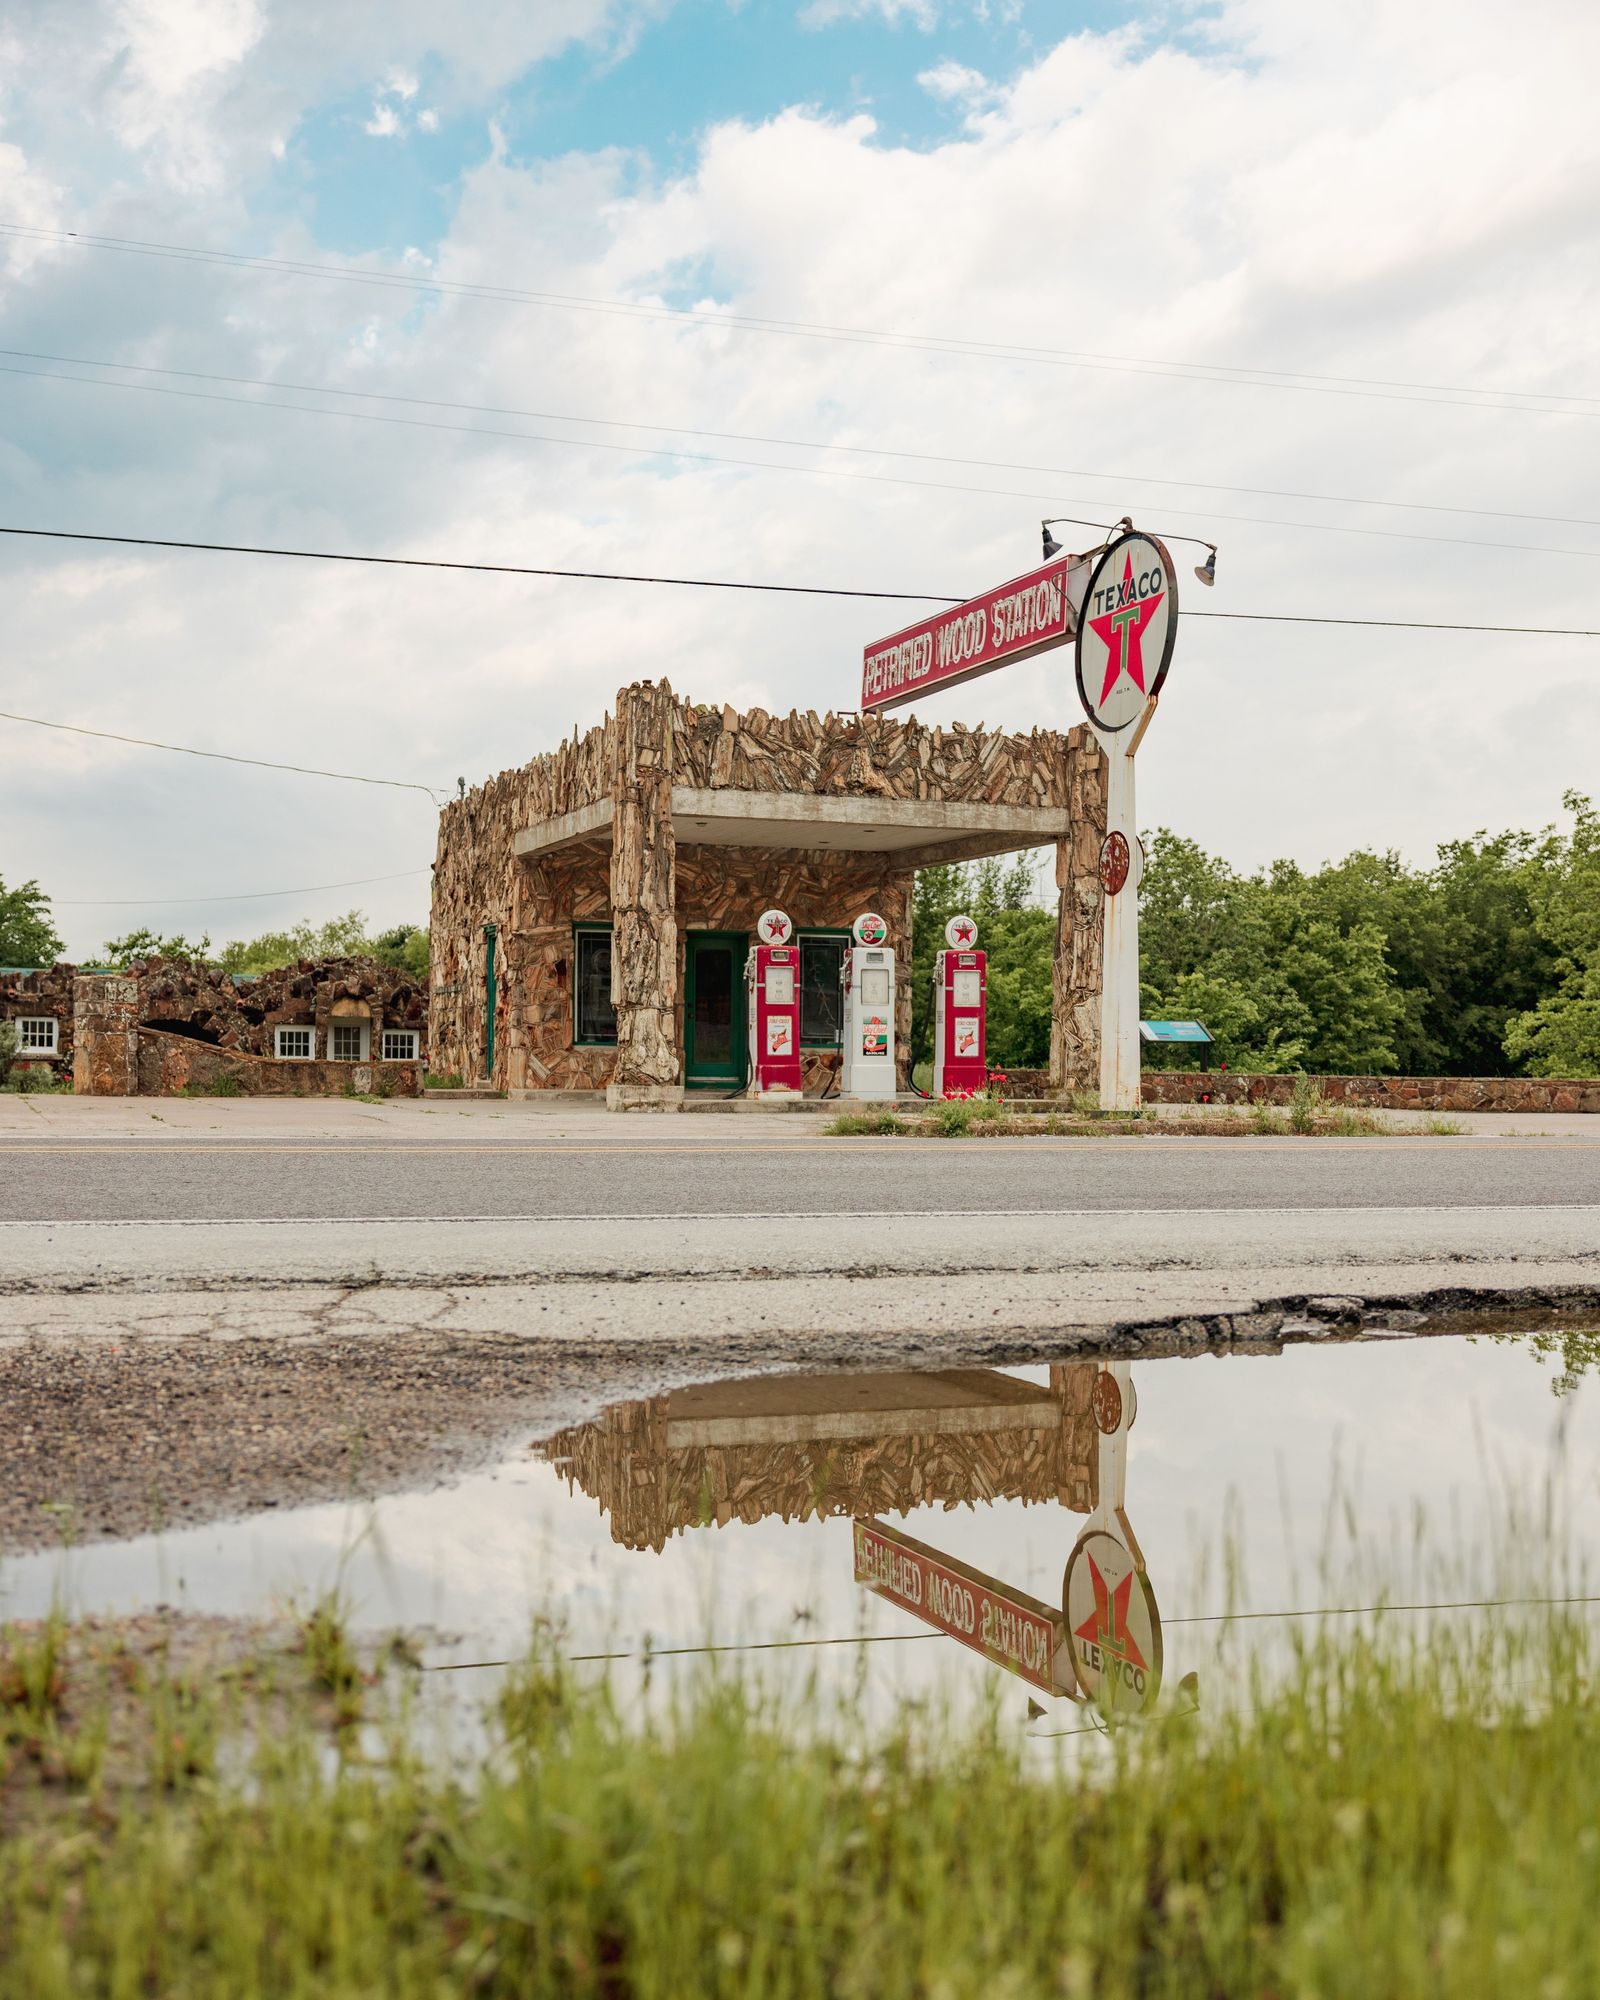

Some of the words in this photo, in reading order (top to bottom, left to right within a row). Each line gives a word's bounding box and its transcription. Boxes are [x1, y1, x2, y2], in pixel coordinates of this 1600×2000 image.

[1094, 567, 1162, 615] TEXACO
[863, 632, 932, 697] PETRIFIED
[936, 609, 987, 668] WOOD
[991, 574, 1062, 647] STATION
[1111, 606, 1140, 671] T
